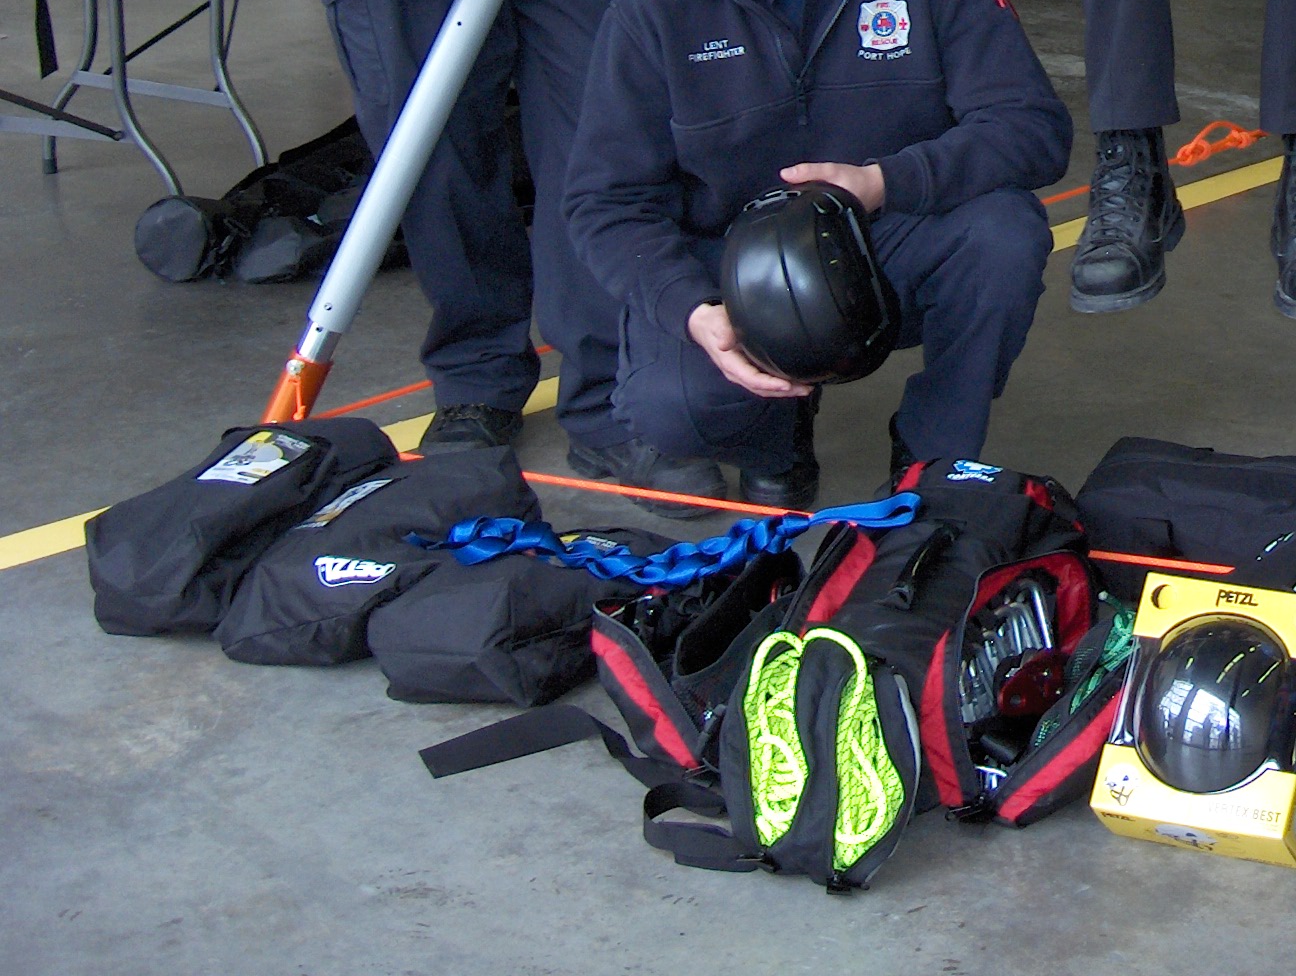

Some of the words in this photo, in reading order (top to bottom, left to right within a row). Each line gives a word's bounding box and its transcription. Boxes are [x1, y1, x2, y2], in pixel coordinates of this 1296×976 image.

[703, 39, 729, 51] LENT
[688, 46, 745, 62] FIREFIGHTER
[858, 50, 883, 60] PORT
[887, 47, 912, 60] HOPE
[314, 555, 396, 583] PETZL
[1216, 589, 1259, 607] PETZL
[1252, 809, 1282, 823] BEST
